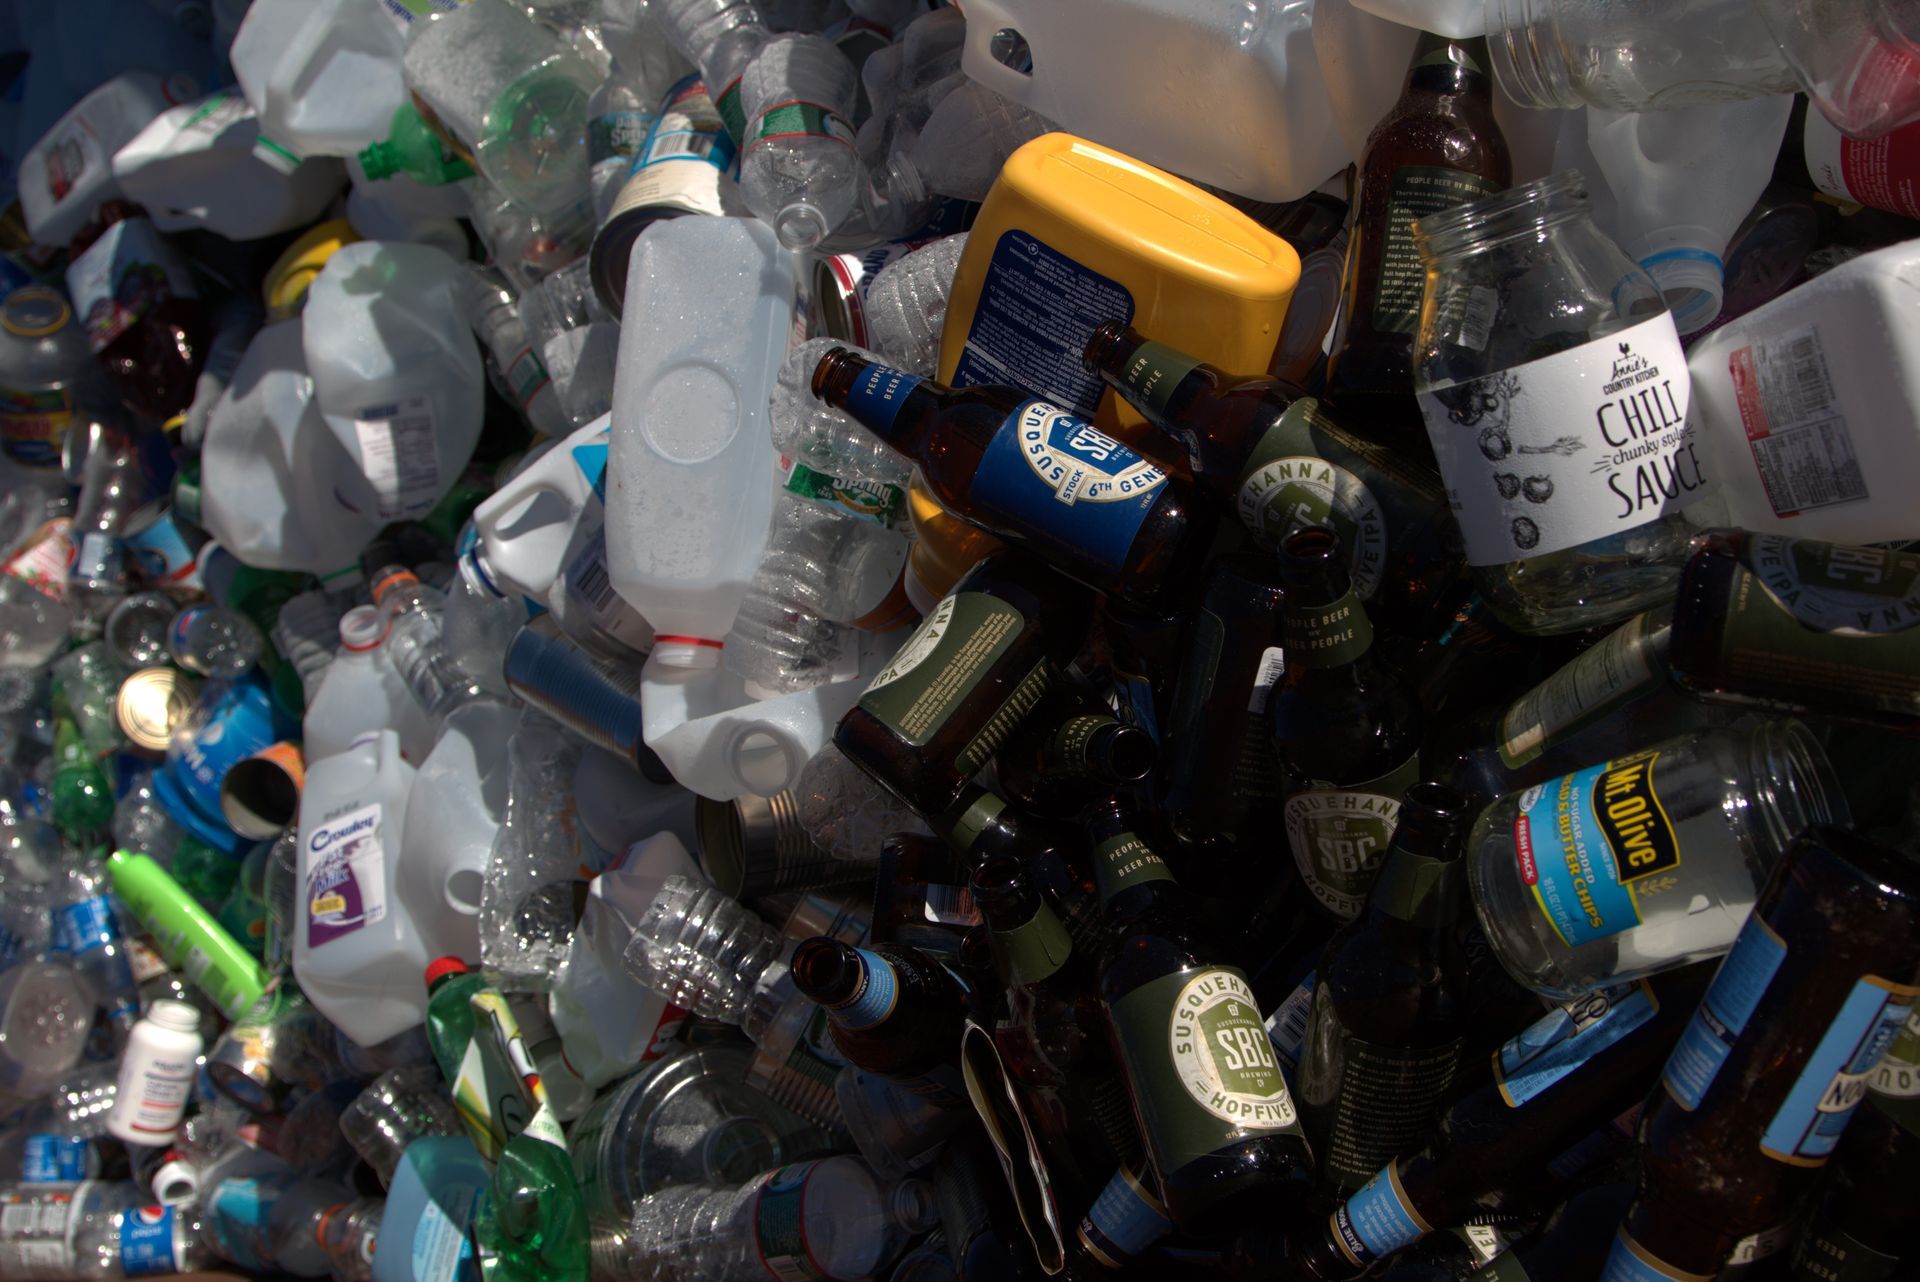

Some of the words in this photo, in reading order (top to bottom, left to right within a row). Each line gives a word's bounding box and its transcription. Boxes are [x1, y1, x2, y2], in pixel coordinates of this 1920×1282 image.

[1127, 357, 1149, 384] BEER
[1603, 377, 1634, 395] COUNTRY
[1635, 366, 1659, 383] KITCHEN
[1611, 357, 1648, 381] Annie's
[883, 378, 900, 400] BEER
[1597, 380, 1682, 447] CHILI
[1613, 438, 1659, 465] chunky
[1662, 426, 1686, 448] style
[1063, 469, 1084, 500] STOCK
[1088, 482, 1112, 497] 6TH
[1608, 442, 1707, 519] SAUCE
[1322, 607, 1350, 626] BEER
[1311, 628, 1354, 649] PEOPLE
[1570, 786, 1579, 800] NO
[1604, 763, 1645, 803] Mt.
[1558, 801, 1569, 812] &
[1570, 801, 1583, 839] SUGAR
[1518, 819, 1529, 851] FRESH
[1558, 814, 1581, 877] BUTTER
[1607, 795, 1657, 868] Olive
[1118, 859, 1144, 877] BEER
[1316, 836, 1382, 873] SBC
[1520, 852, 1535, 880] PACK
[1575, 841, 1595, 884] ADDED
[1573, 877, 1604, 928] CHIPS
[1216, 1027, 1273, 1071] SBC
[1211, 1091, 1291, 1121] HOPFIVE
[1343, 1226, 1366, 1254] BLUE
